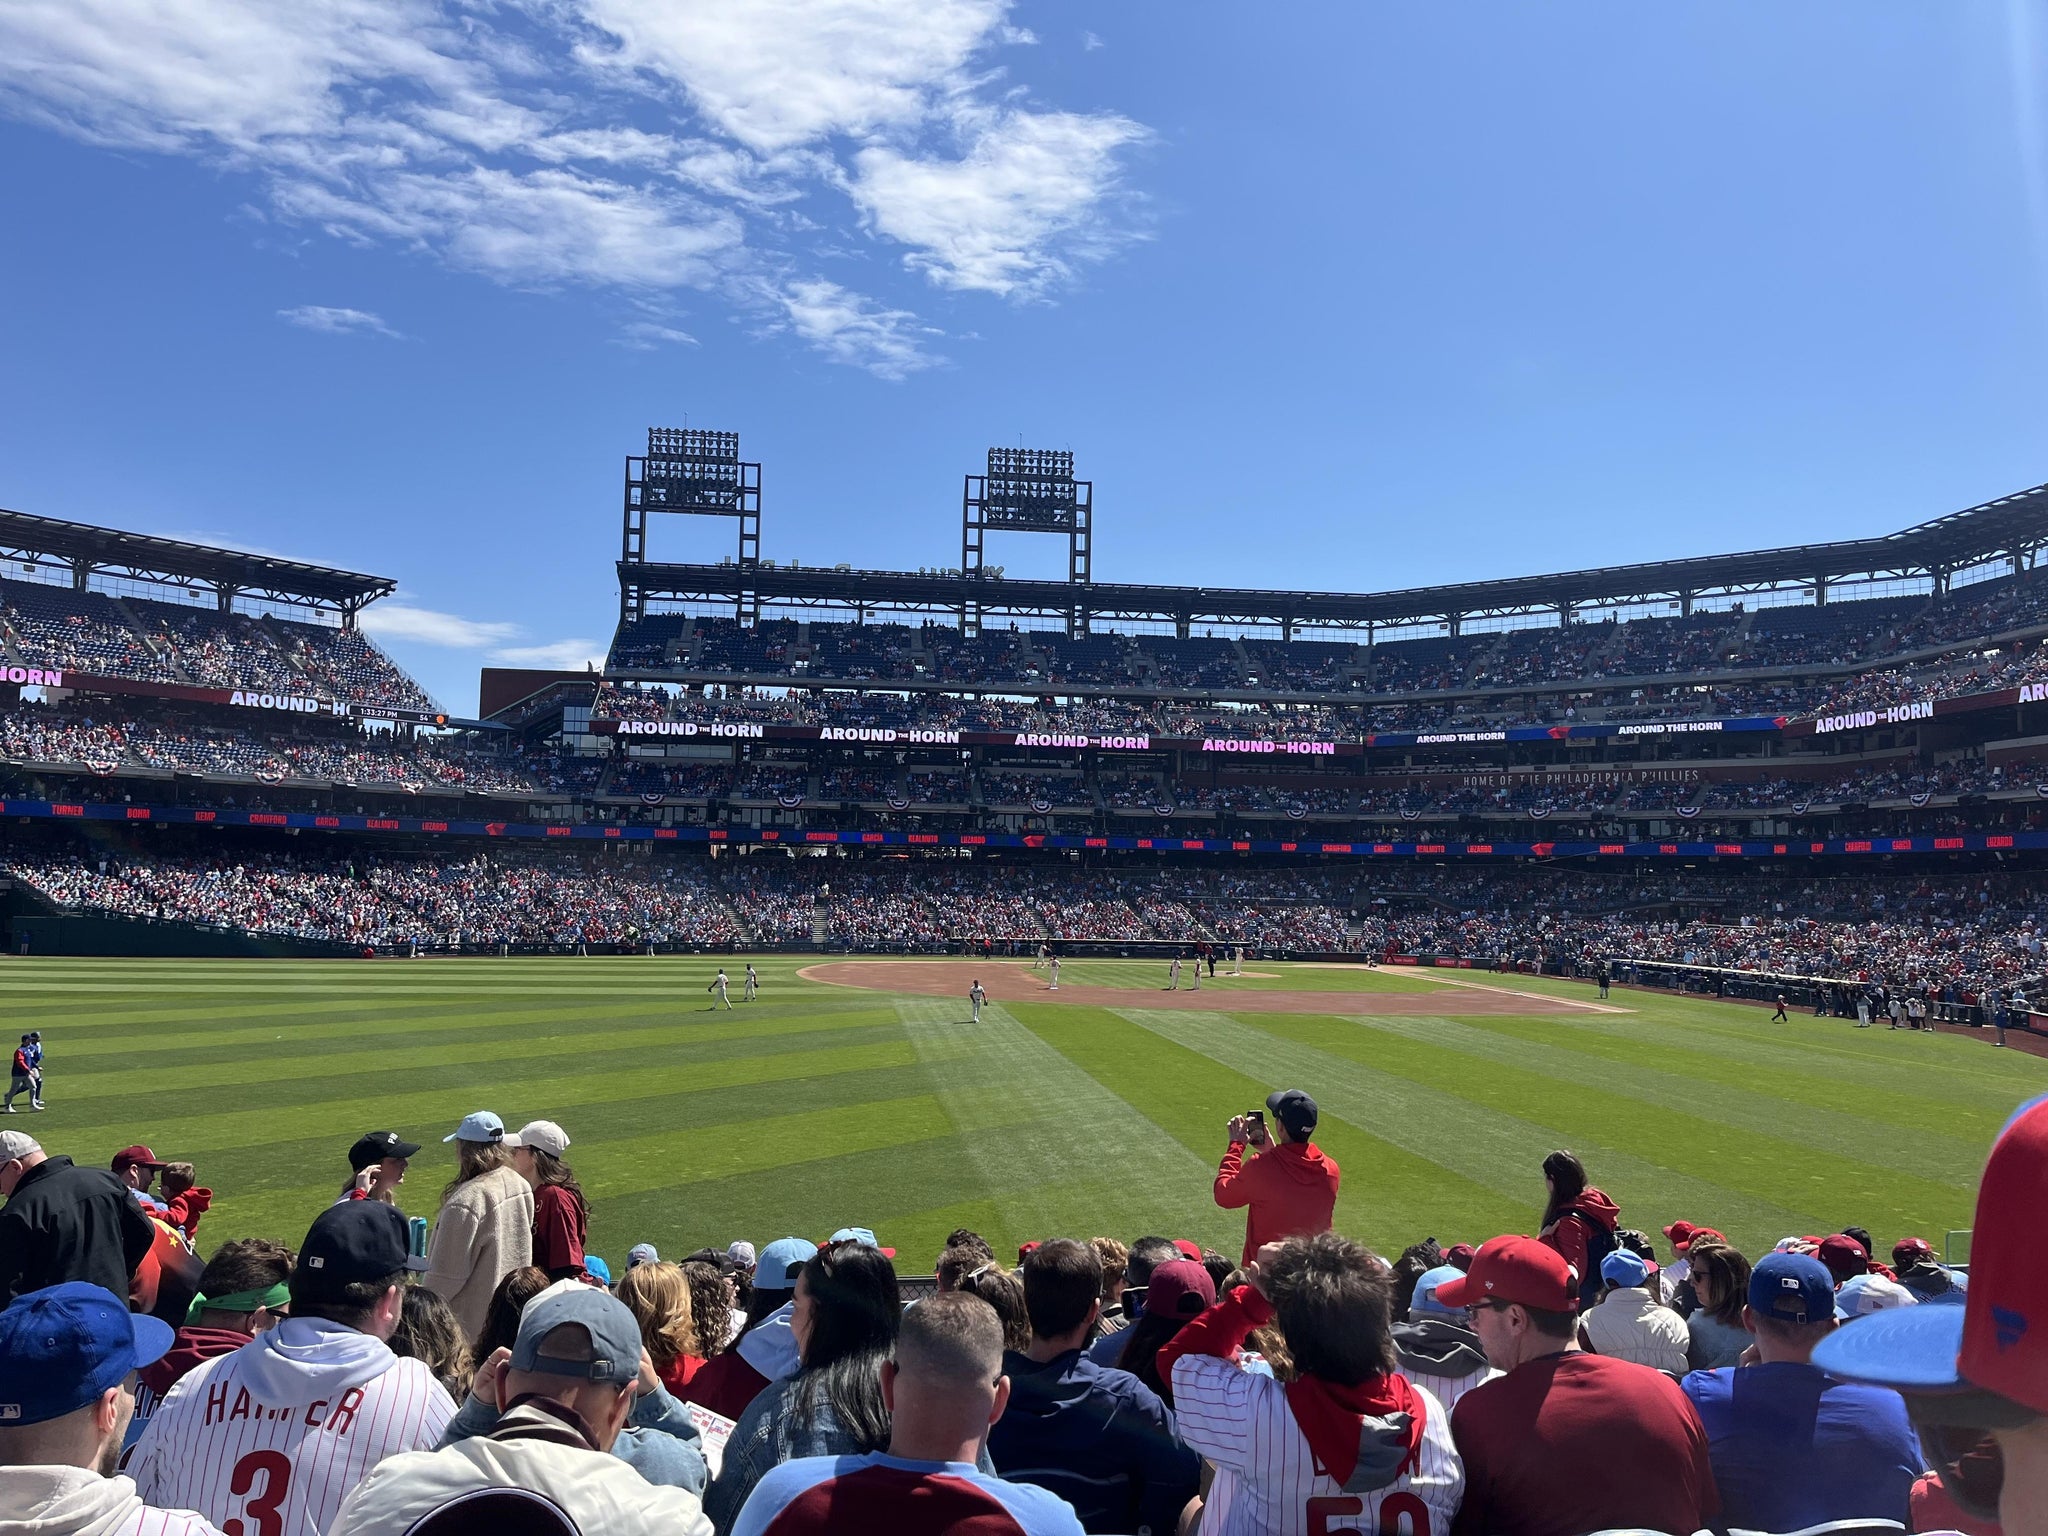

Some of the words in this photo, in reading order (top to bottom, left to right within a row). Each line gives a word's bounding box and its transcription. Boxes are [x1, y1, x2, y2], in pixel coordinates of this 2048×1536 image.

[229, 691, 318, 713] AROUND
[319, 703, 331, 711] THE
[332, 702, 350, 716] H
[360, 707, 387, 717] 1:33:27
[388, 710, 398, 719] PM
[1815, 710, 1877, 734] AROUND
[1877, 712, 1887, 720] THE
[1887, 701, 1934, 723] HORN
[617, 721, 697, 736] AROUND
[711, 724, 763, 738] HORN
[819, 727, 897, 742] AROUND
[898, 732, 909, 740] THE
[909, 730, 960, 744] HORN
[1618, 724, 1665, 735] AROUND
[1666, 722, 1688, 733] THE
[1688, 721, 1723, 732] HORN
[1014, 733, 1089, 748] AROUND
[1101, 735, 1150, 749] HORN
[1416, 734, 1457, 744] AROUND
[1457, 733, 1477, 742] THE
[1477, 731, 1505, 741] HORN
[1202, 739, 1275, 754] AROUND
[1287, 742, 1335, 755] HORN
[1463, 775, 1494, 786] HOME
[1500, 775, 1513, 785] OF
[52, 804, 84, 816] TURNER
[205, 1380, 366, 1436] HAER
[223, 1449, 292, 1536] 3
